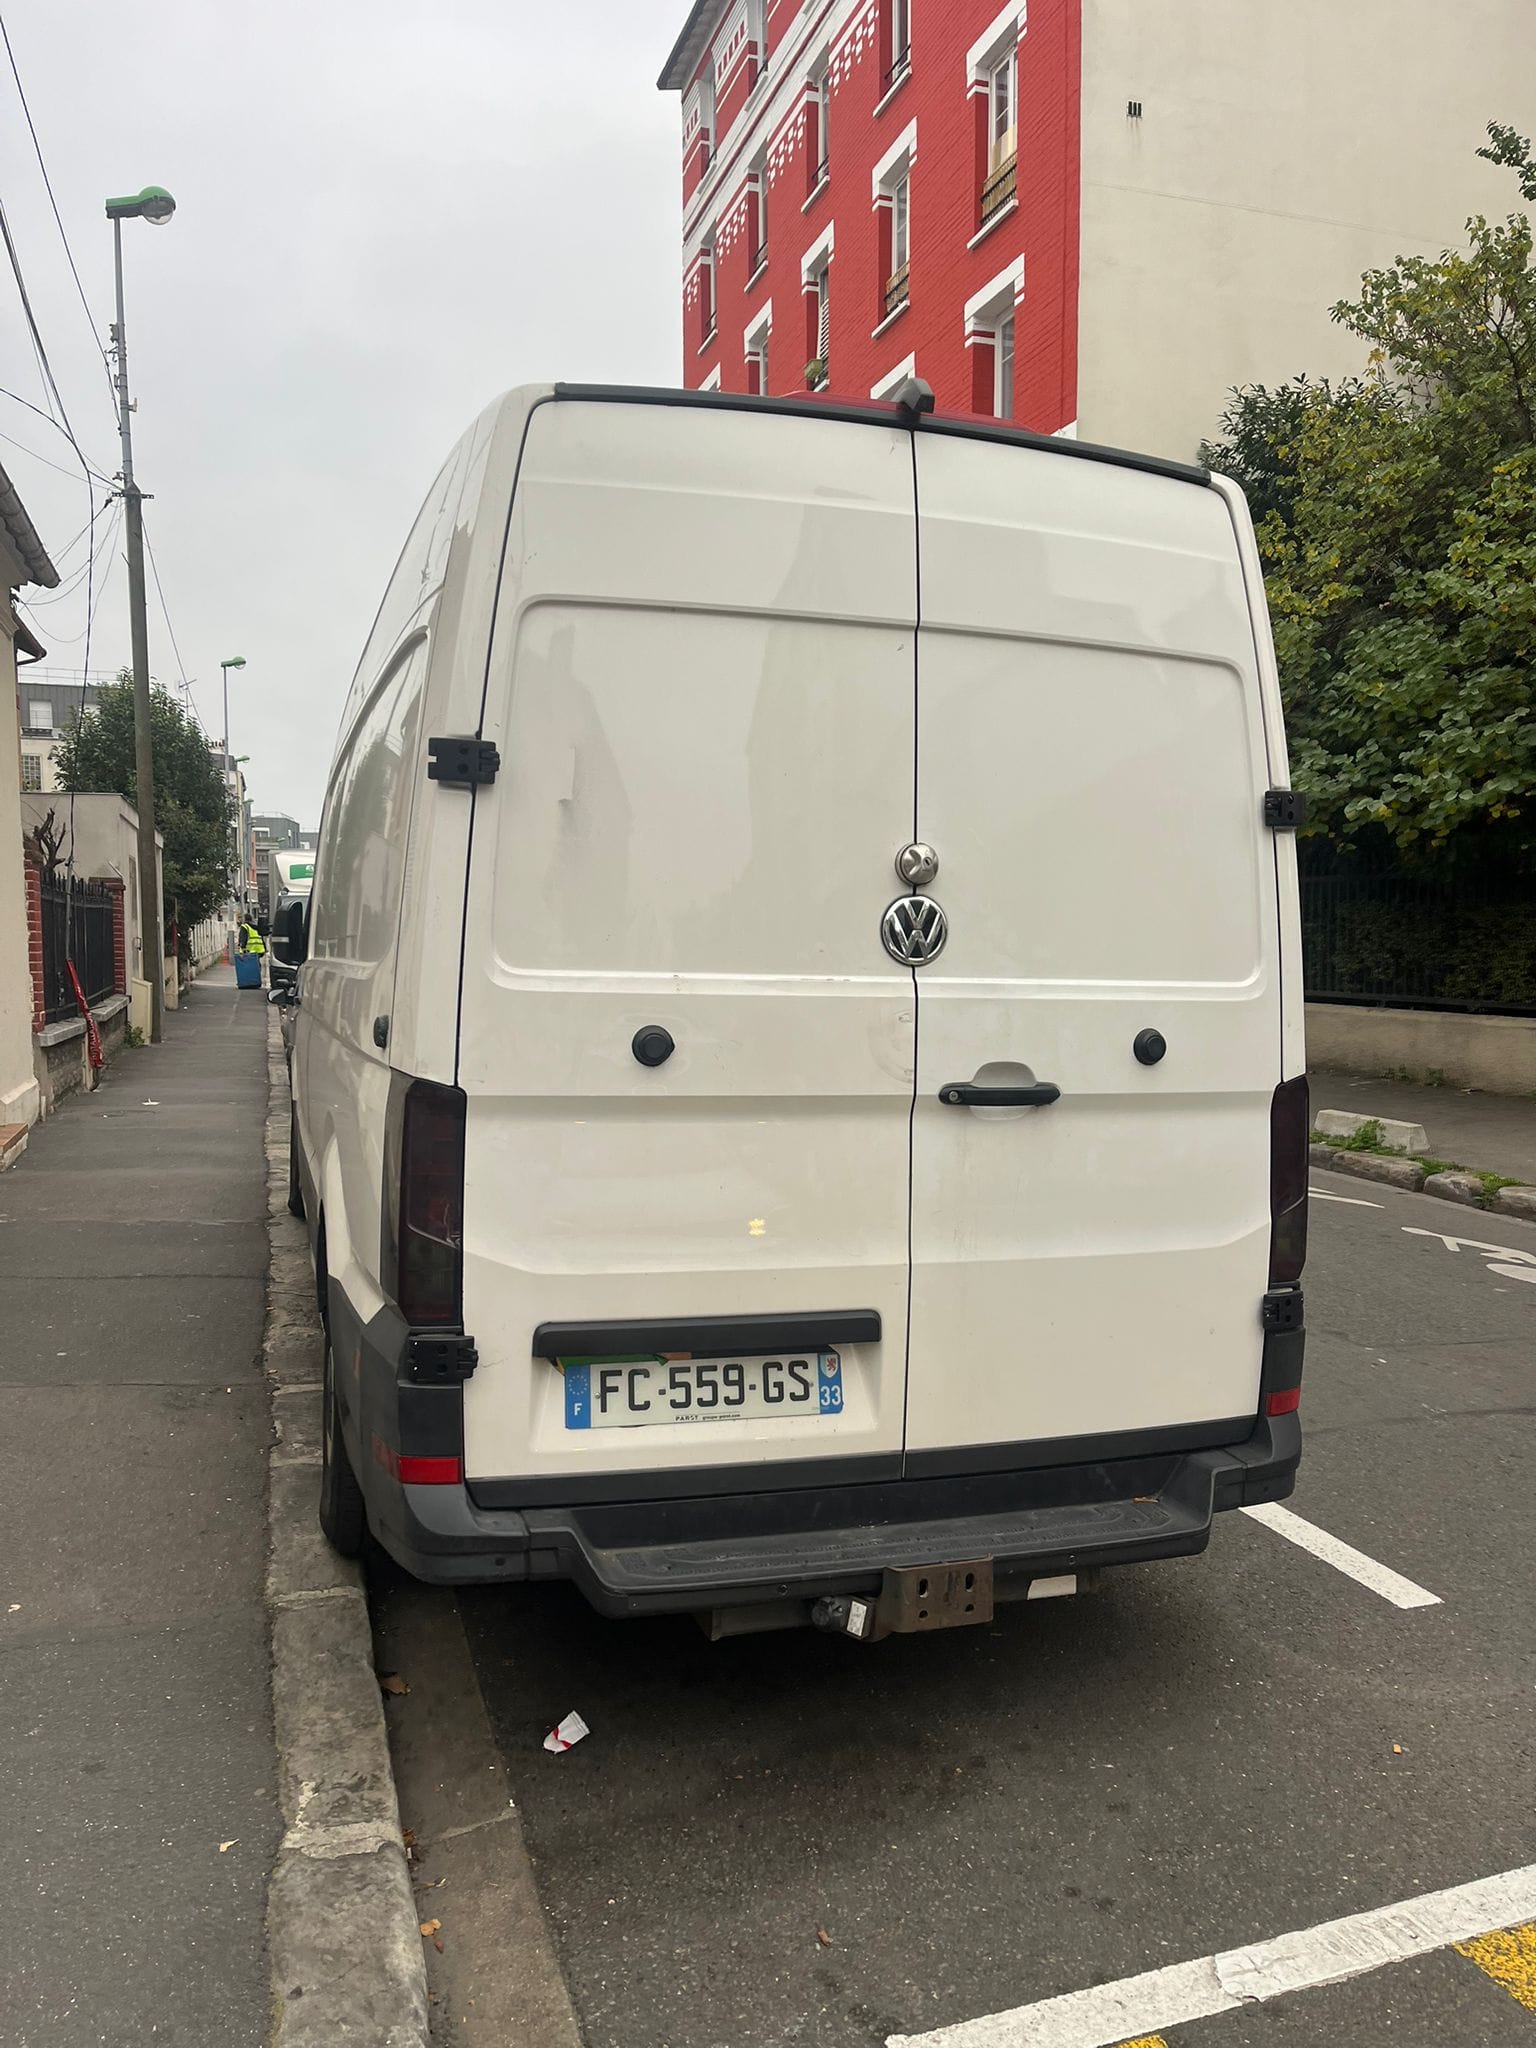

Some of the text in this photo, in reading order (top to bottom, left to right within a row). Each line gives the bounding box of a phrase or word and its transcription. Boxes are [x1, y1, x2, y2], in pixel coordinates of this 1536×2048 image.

[883, 897, 944, 961] VW
[599, 1360, 810, 1413] FC-559-GS
[820, 1385, 841, 1406] 33
[573, 1402, 583, 1416] F
